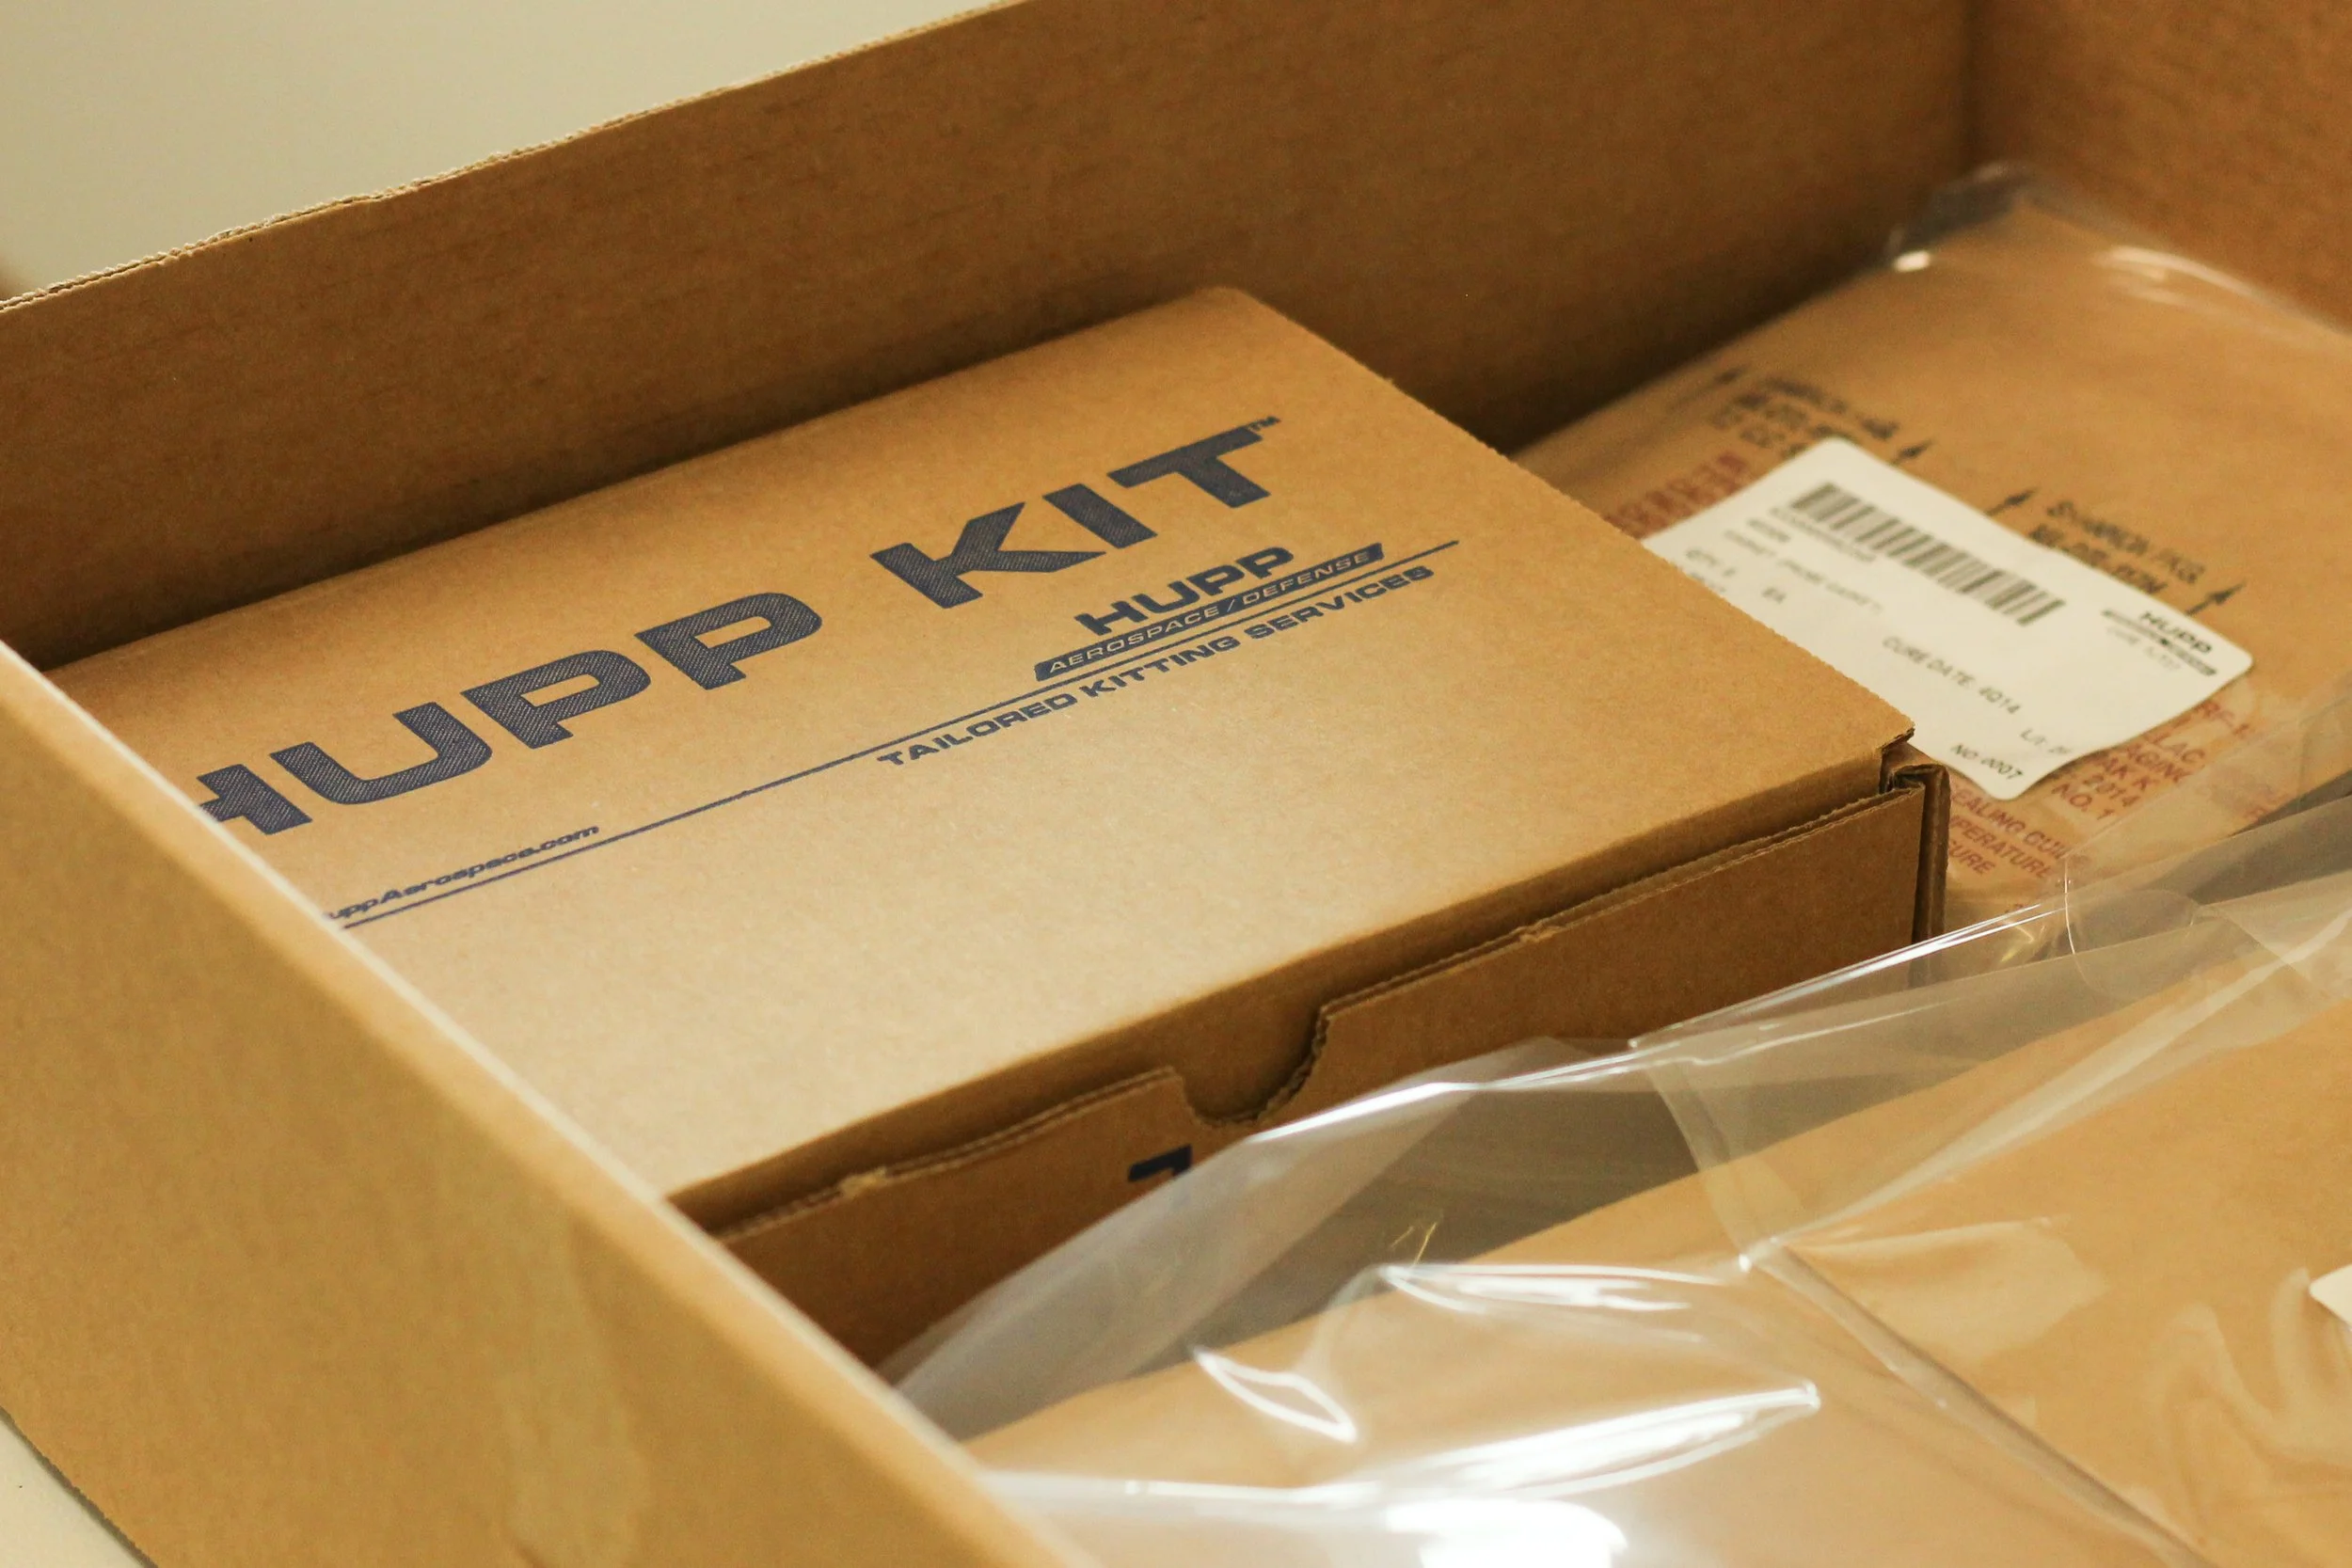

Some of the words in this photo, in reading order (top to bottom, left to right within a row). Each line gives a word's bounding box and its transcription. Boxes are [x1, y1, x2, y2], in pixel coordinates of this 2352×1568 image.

[870, 425, 1271, 609] KIT
[1074, 546, 1295, 637] HUPP
[877, 691, 1079, 768] TAILORED
[1082, 635, 1241, 698] KITTING
[1248, 566, 1435, 641] SERVICES
[1883, 636, 1931, 664] CURE
[2139, 611, 2213, 654] HUPP
[1950, 786, 2026, 835] EALING
[1950, 815, 2055, 879] PERATURE
[325, 826, 599, 919] uppAerospace.com
